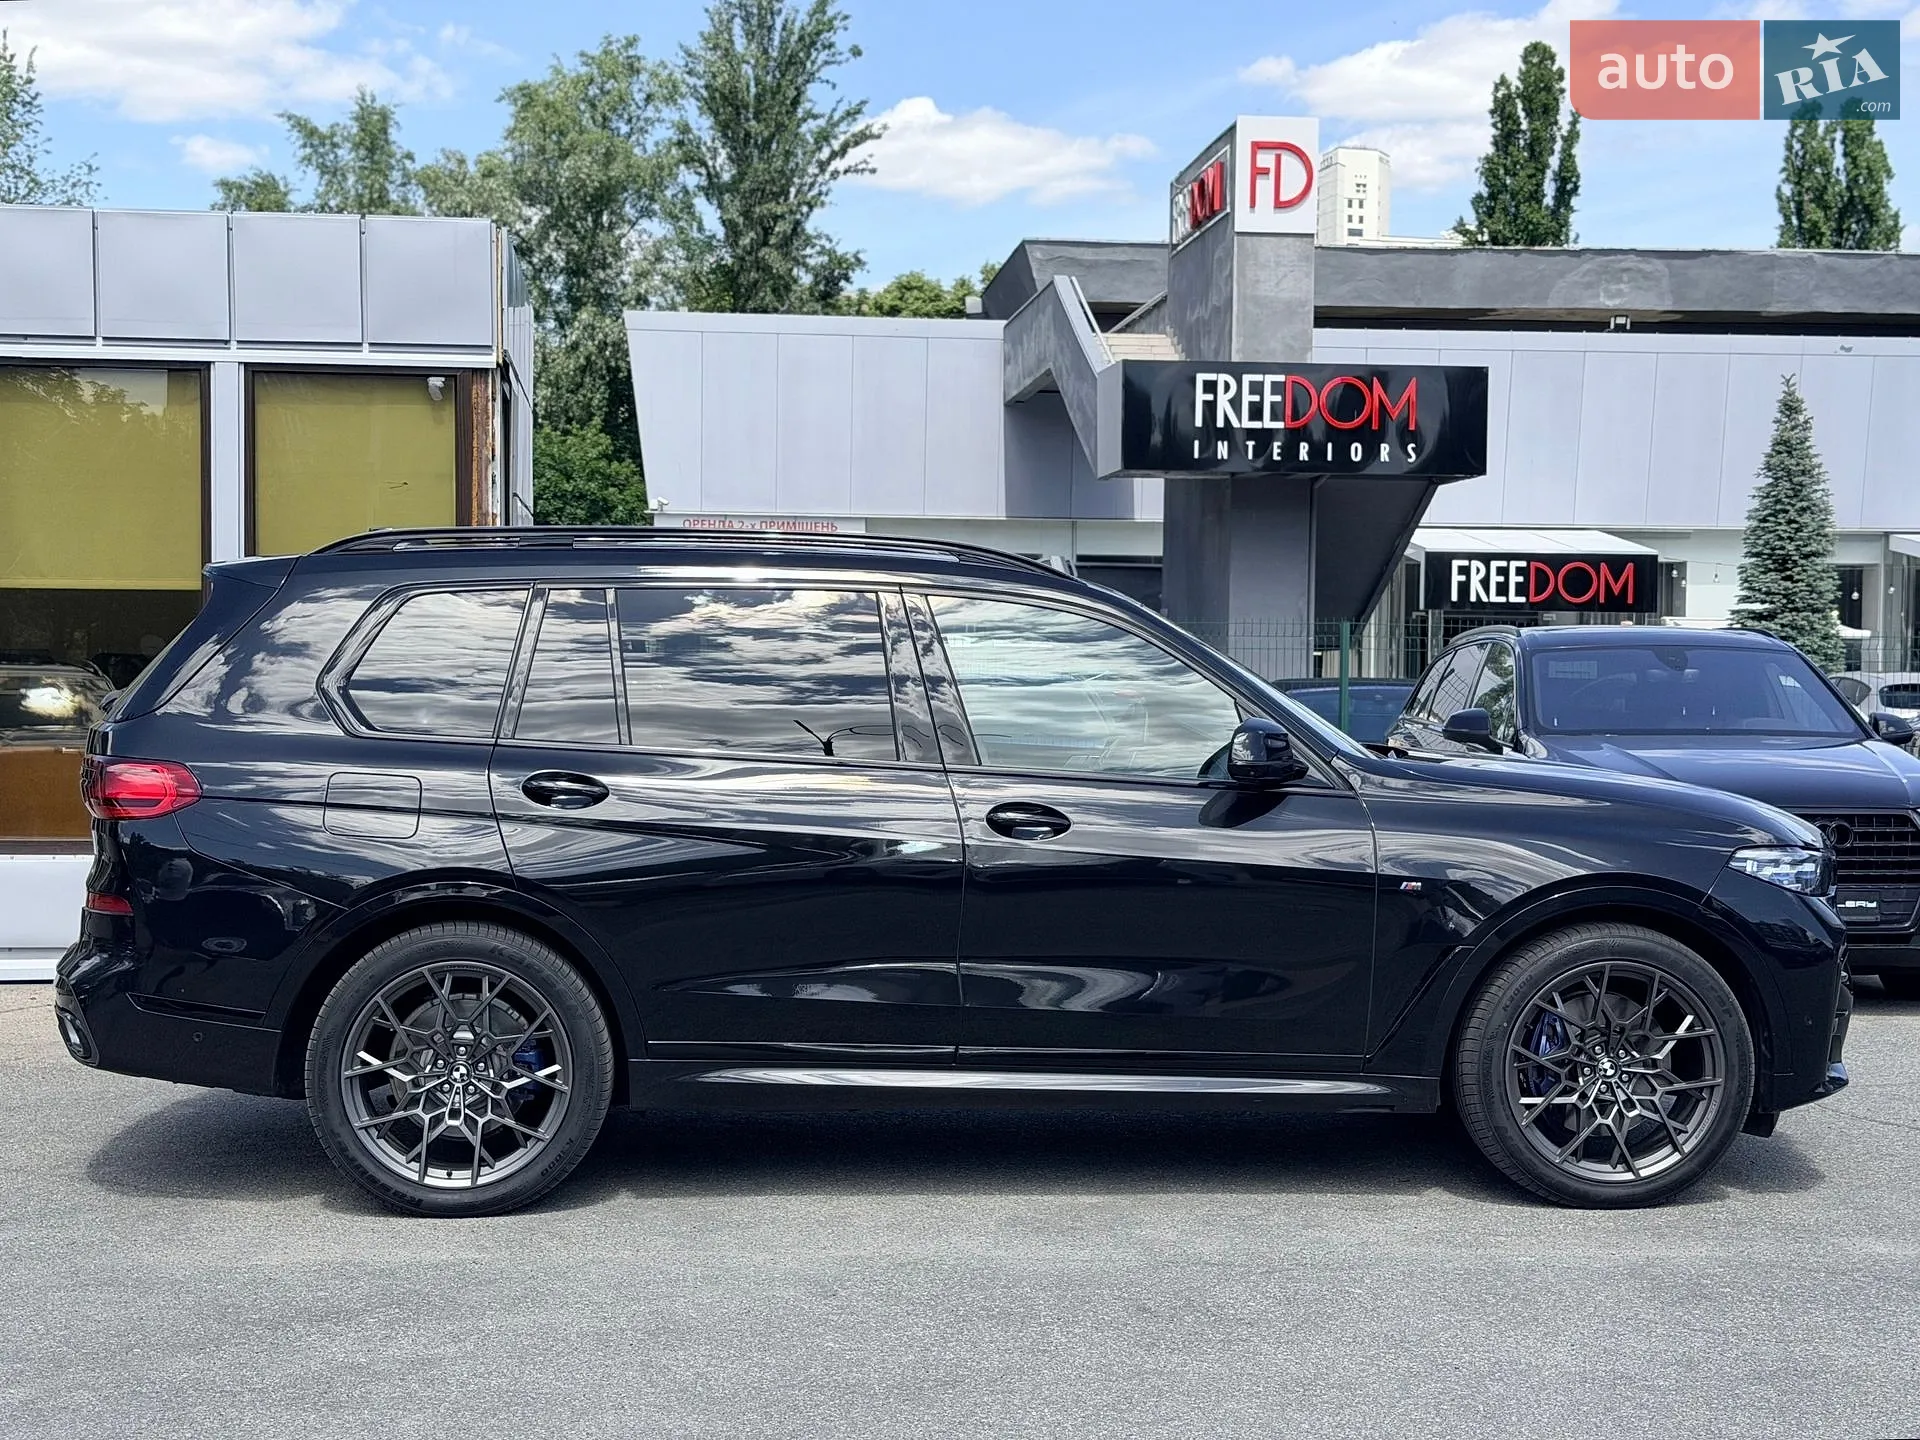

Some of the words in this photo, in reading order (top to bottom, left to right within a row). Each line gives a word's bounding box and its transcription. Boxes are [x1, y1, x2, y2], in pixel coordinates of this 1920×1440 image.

[1249, 141, 1314, 209] FD
[1195, 373, 1417, 431] FREEDOM
[1193, 440, 1417, 463] INTERIORS
[682, 518, 735, 529] ОРЕНДА
[1451, 560, 1635, 605] FREEDOM
